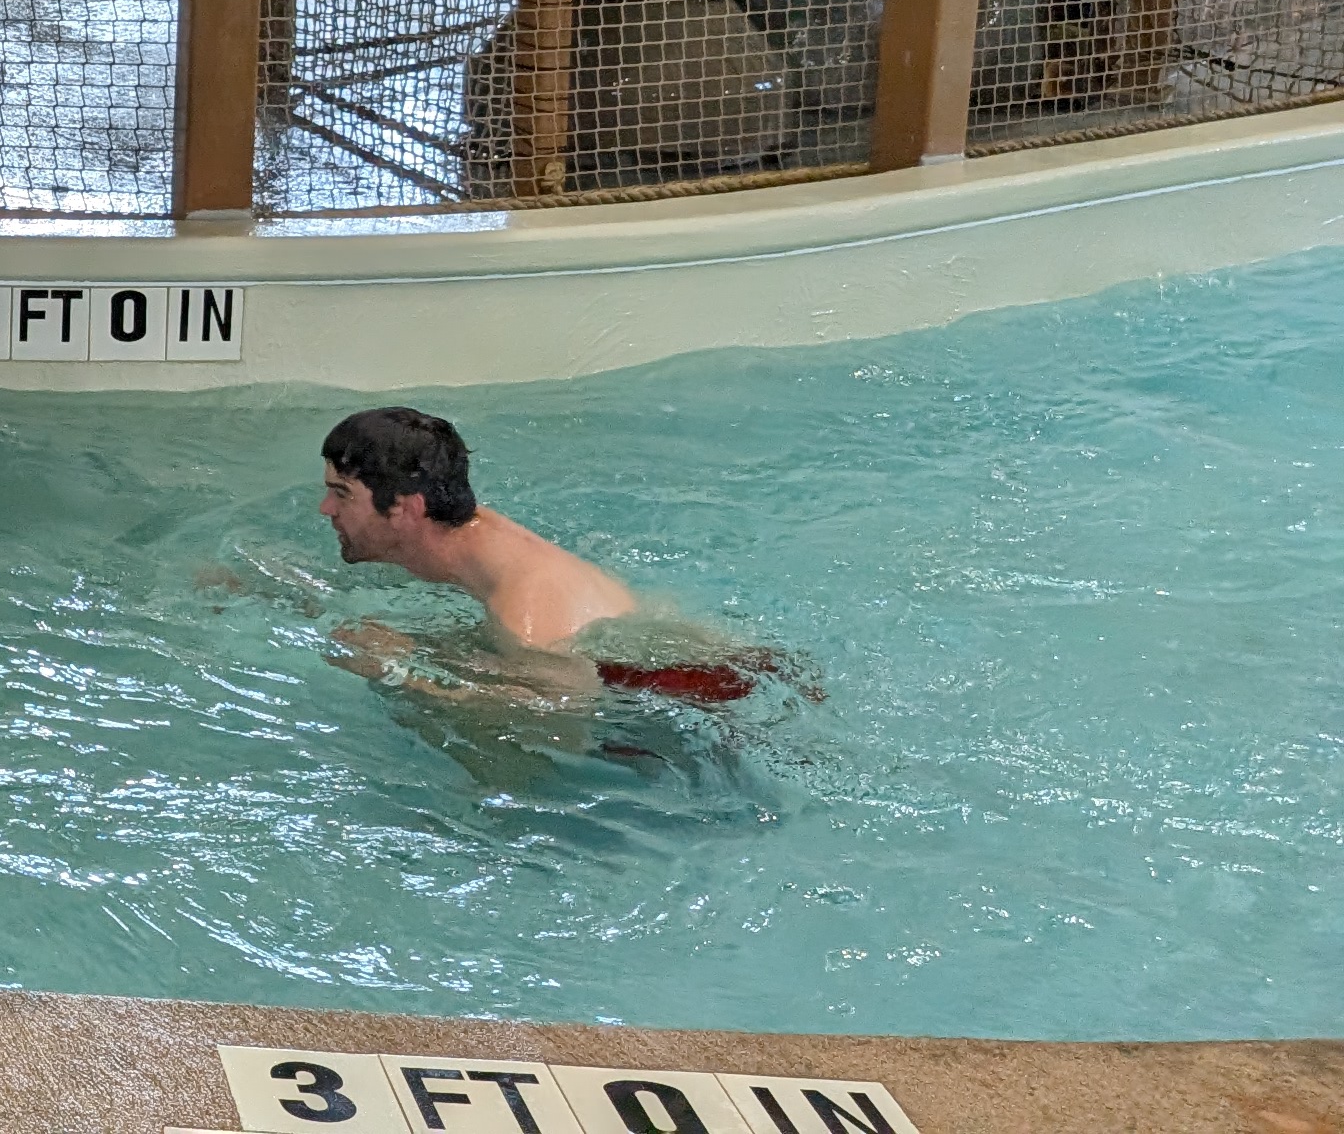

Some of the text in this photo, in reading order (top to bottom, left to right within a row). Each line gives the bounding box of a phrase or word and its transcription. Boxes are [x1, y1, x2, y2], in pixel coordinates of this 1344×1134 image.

[18, 289, 83, 343] FT
[109, 289, 147, 343] 0
[178, 289, 234, 342] IN
[269, 1060, 358, 1124] 3
[399, 1066, 543, 1134] FT
[748, 1085, 898, 1134] IN
